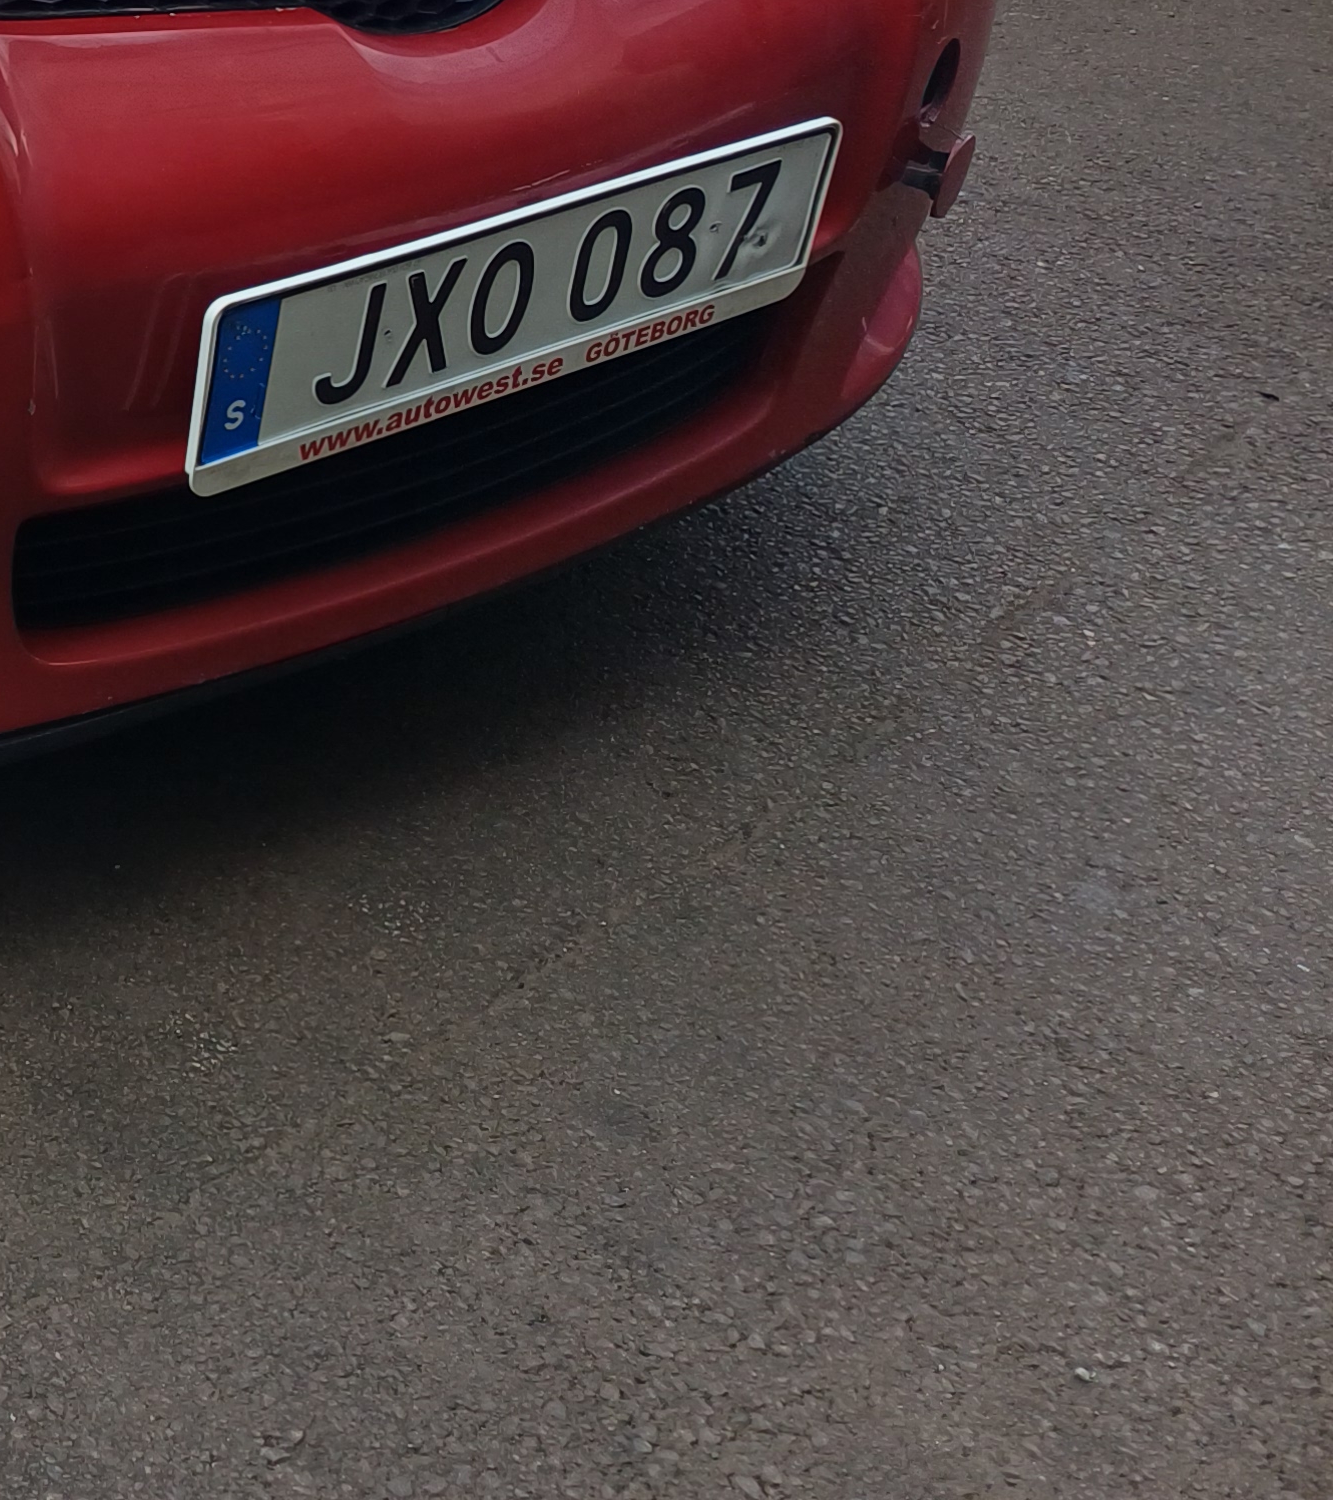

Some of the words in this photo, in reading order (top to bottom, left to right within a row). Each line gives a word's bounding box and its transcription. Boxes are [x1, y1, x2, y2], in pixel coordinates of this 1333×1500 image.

[314, 241, 534, 405] JXO
[569, 159, 782, 323] 087
[224, 399, 246, 431] S
[298, 356, 564, 461] www.autowest.se
[585, 304, 716, 364] GÖTEBORG
